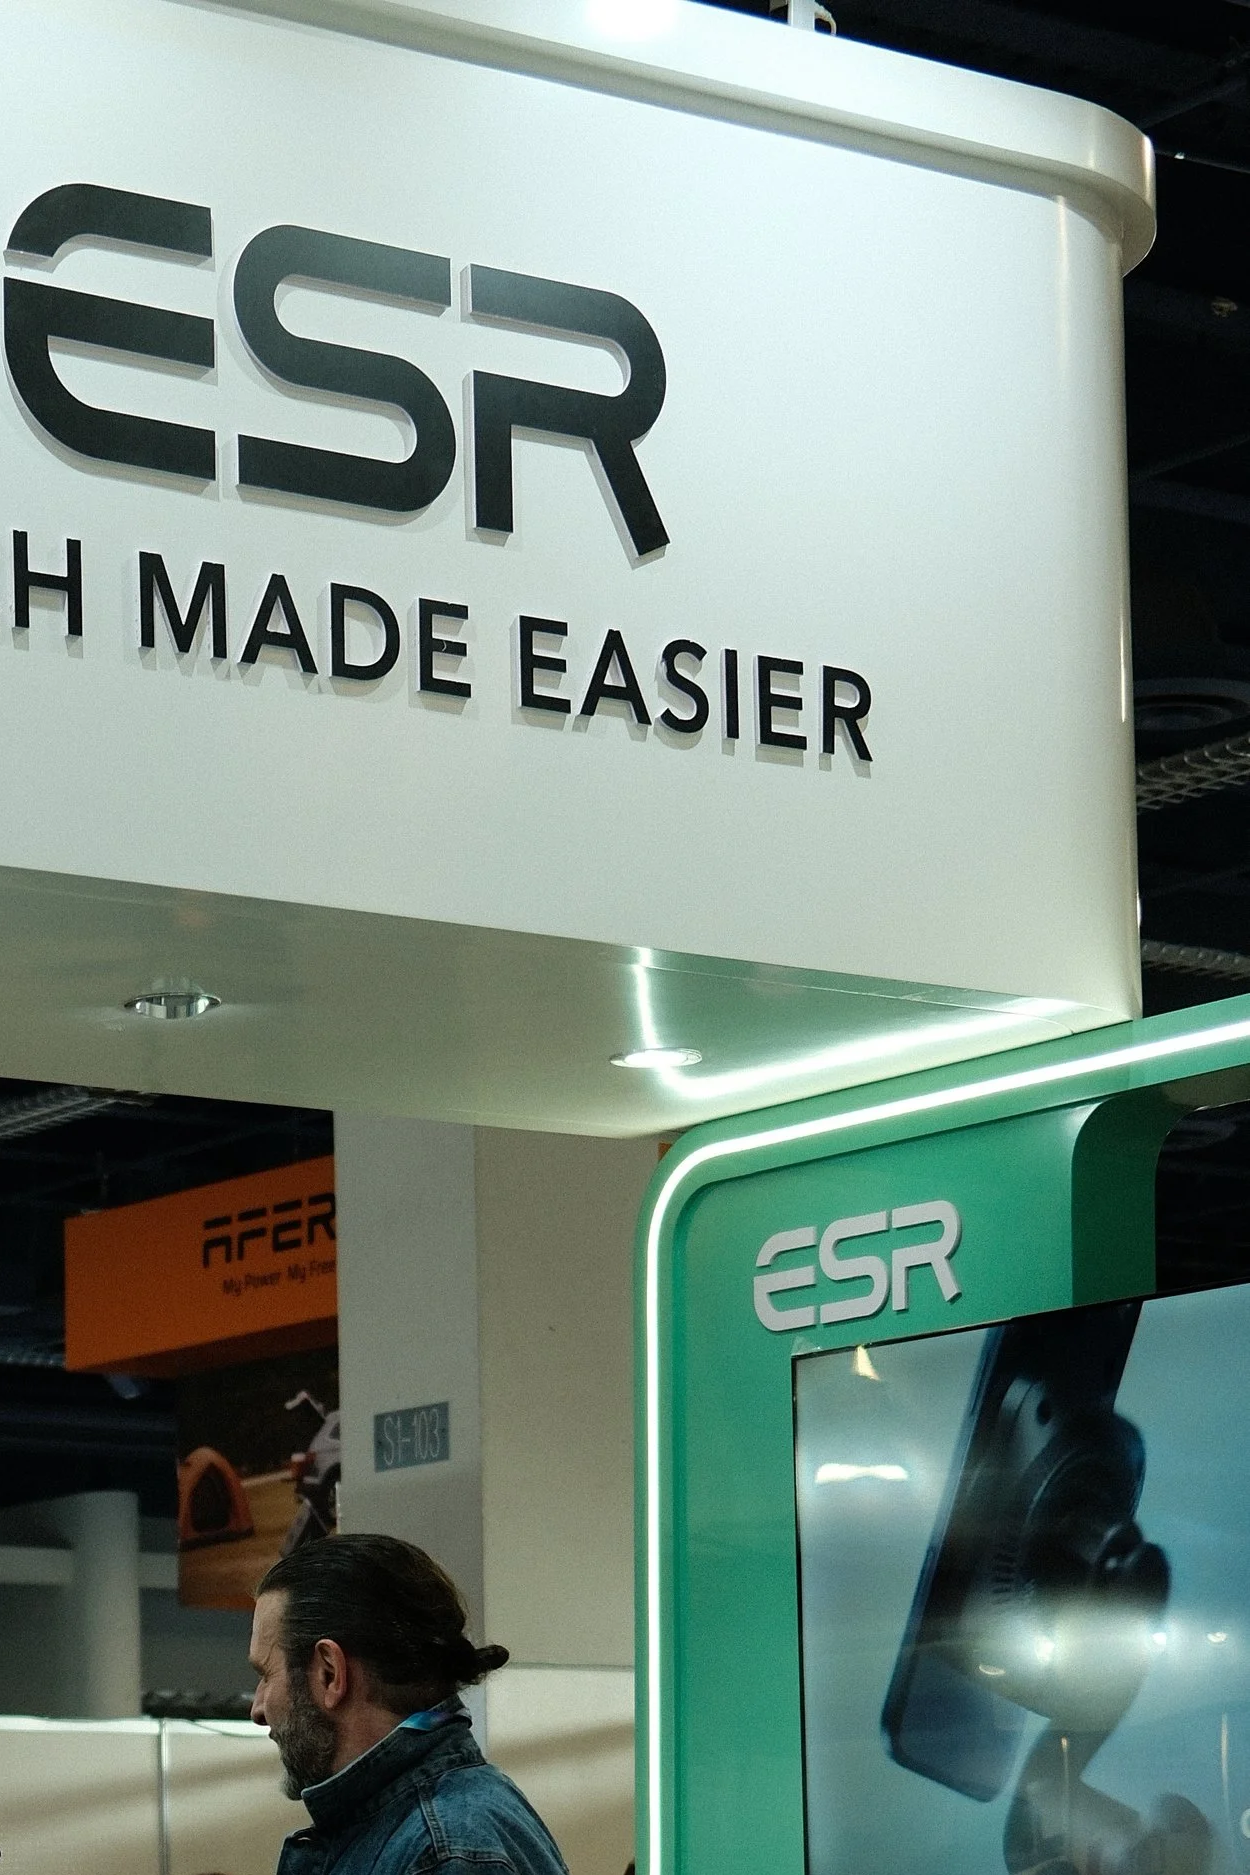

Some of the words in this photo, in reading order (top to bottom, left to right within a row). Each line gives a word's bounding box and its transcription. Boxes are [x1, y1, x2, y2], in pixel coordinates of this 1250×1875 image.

[3, 182, 671, 558] ESR
[136, 550, 472, 700] MADE
[514, 612, 874, 763] EASIER
[753, 1199, 962, 1332] ESR
